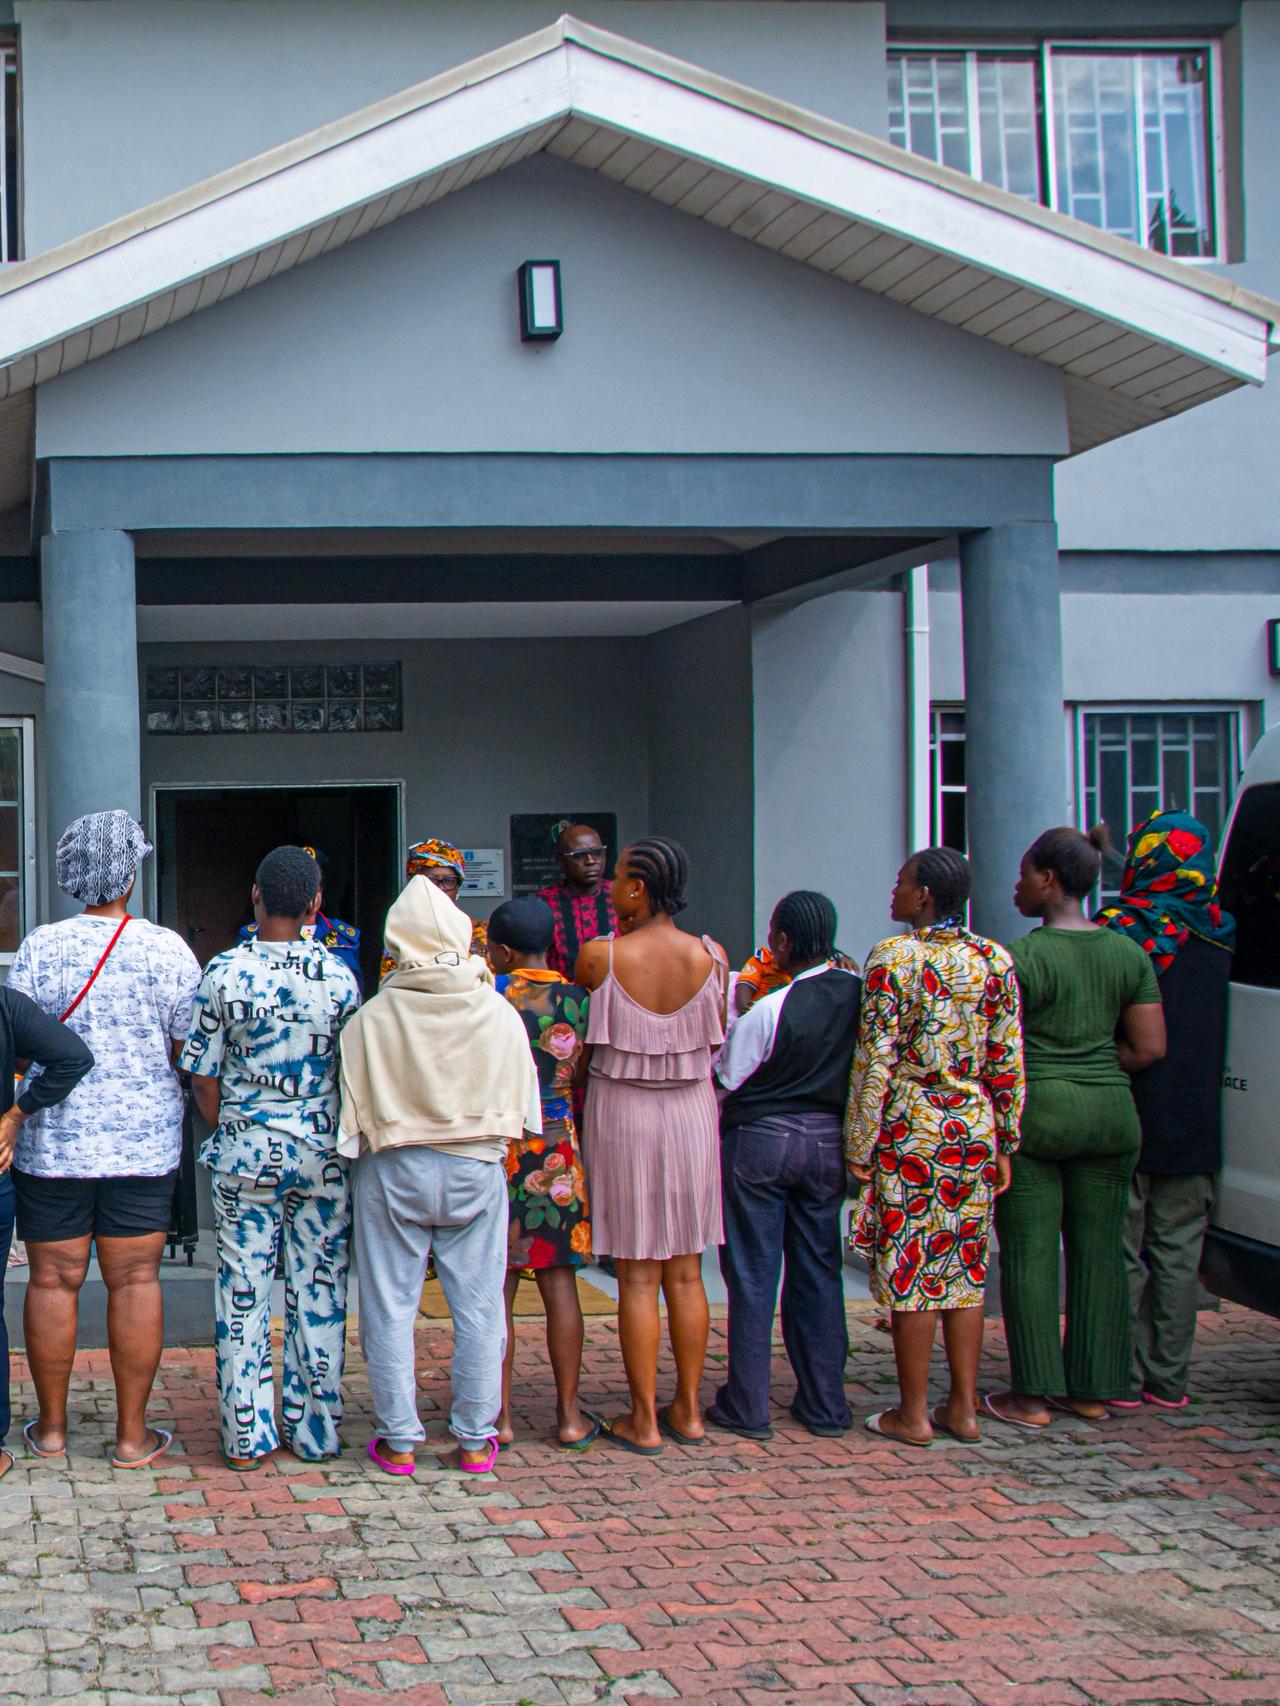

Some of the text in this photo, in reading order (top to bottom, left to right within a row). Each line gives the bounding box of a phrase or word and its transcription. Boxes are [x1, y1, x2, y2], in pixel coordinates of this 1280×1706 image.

[186, 1006, 220, 1065] Dior
[254, 1136, 283, 1190] Dior
[230, 1286, 256, 1346] Dior
[234, 1404, 256, 1458] Dior
